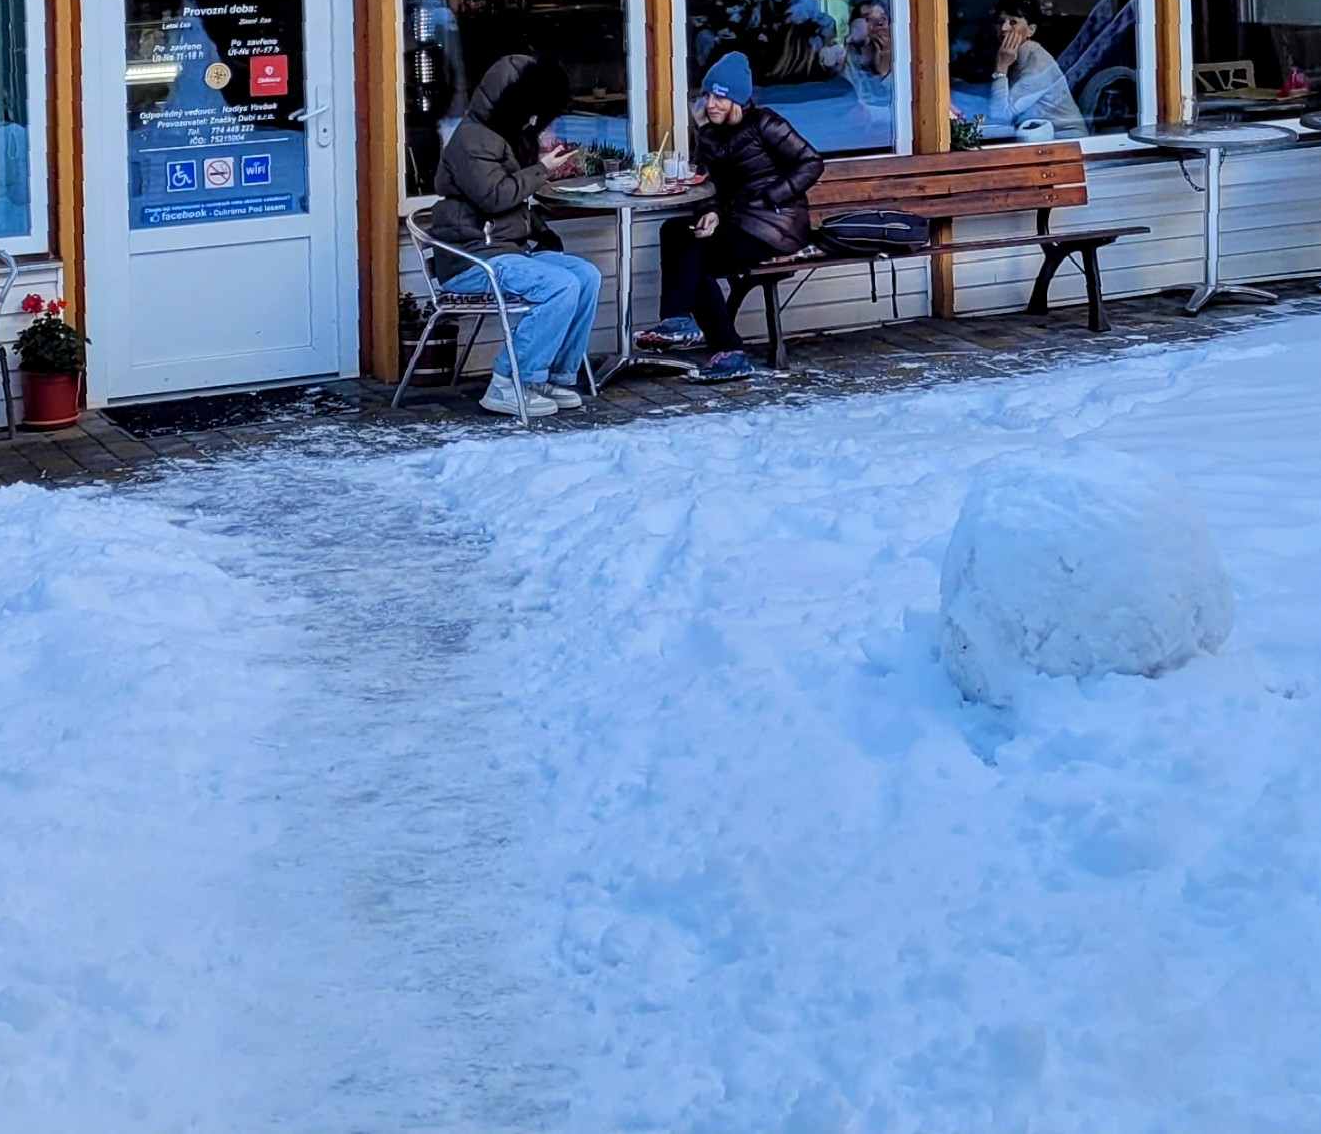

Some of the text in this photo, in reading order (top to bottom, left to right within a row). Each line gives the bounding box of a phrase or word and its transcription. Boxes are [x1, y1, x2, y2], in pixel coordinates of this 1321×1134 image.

[182, 4, 259, 17] Provozní doba:
[231, 37, 278, 47] Po zavřeno
[153, 43, 202, 53] Po zavřeno
[161, 208, 208, 221] facebook
[213, 207, 247, 217] Cukrárna
[248, 204, 264, 214] Pod
